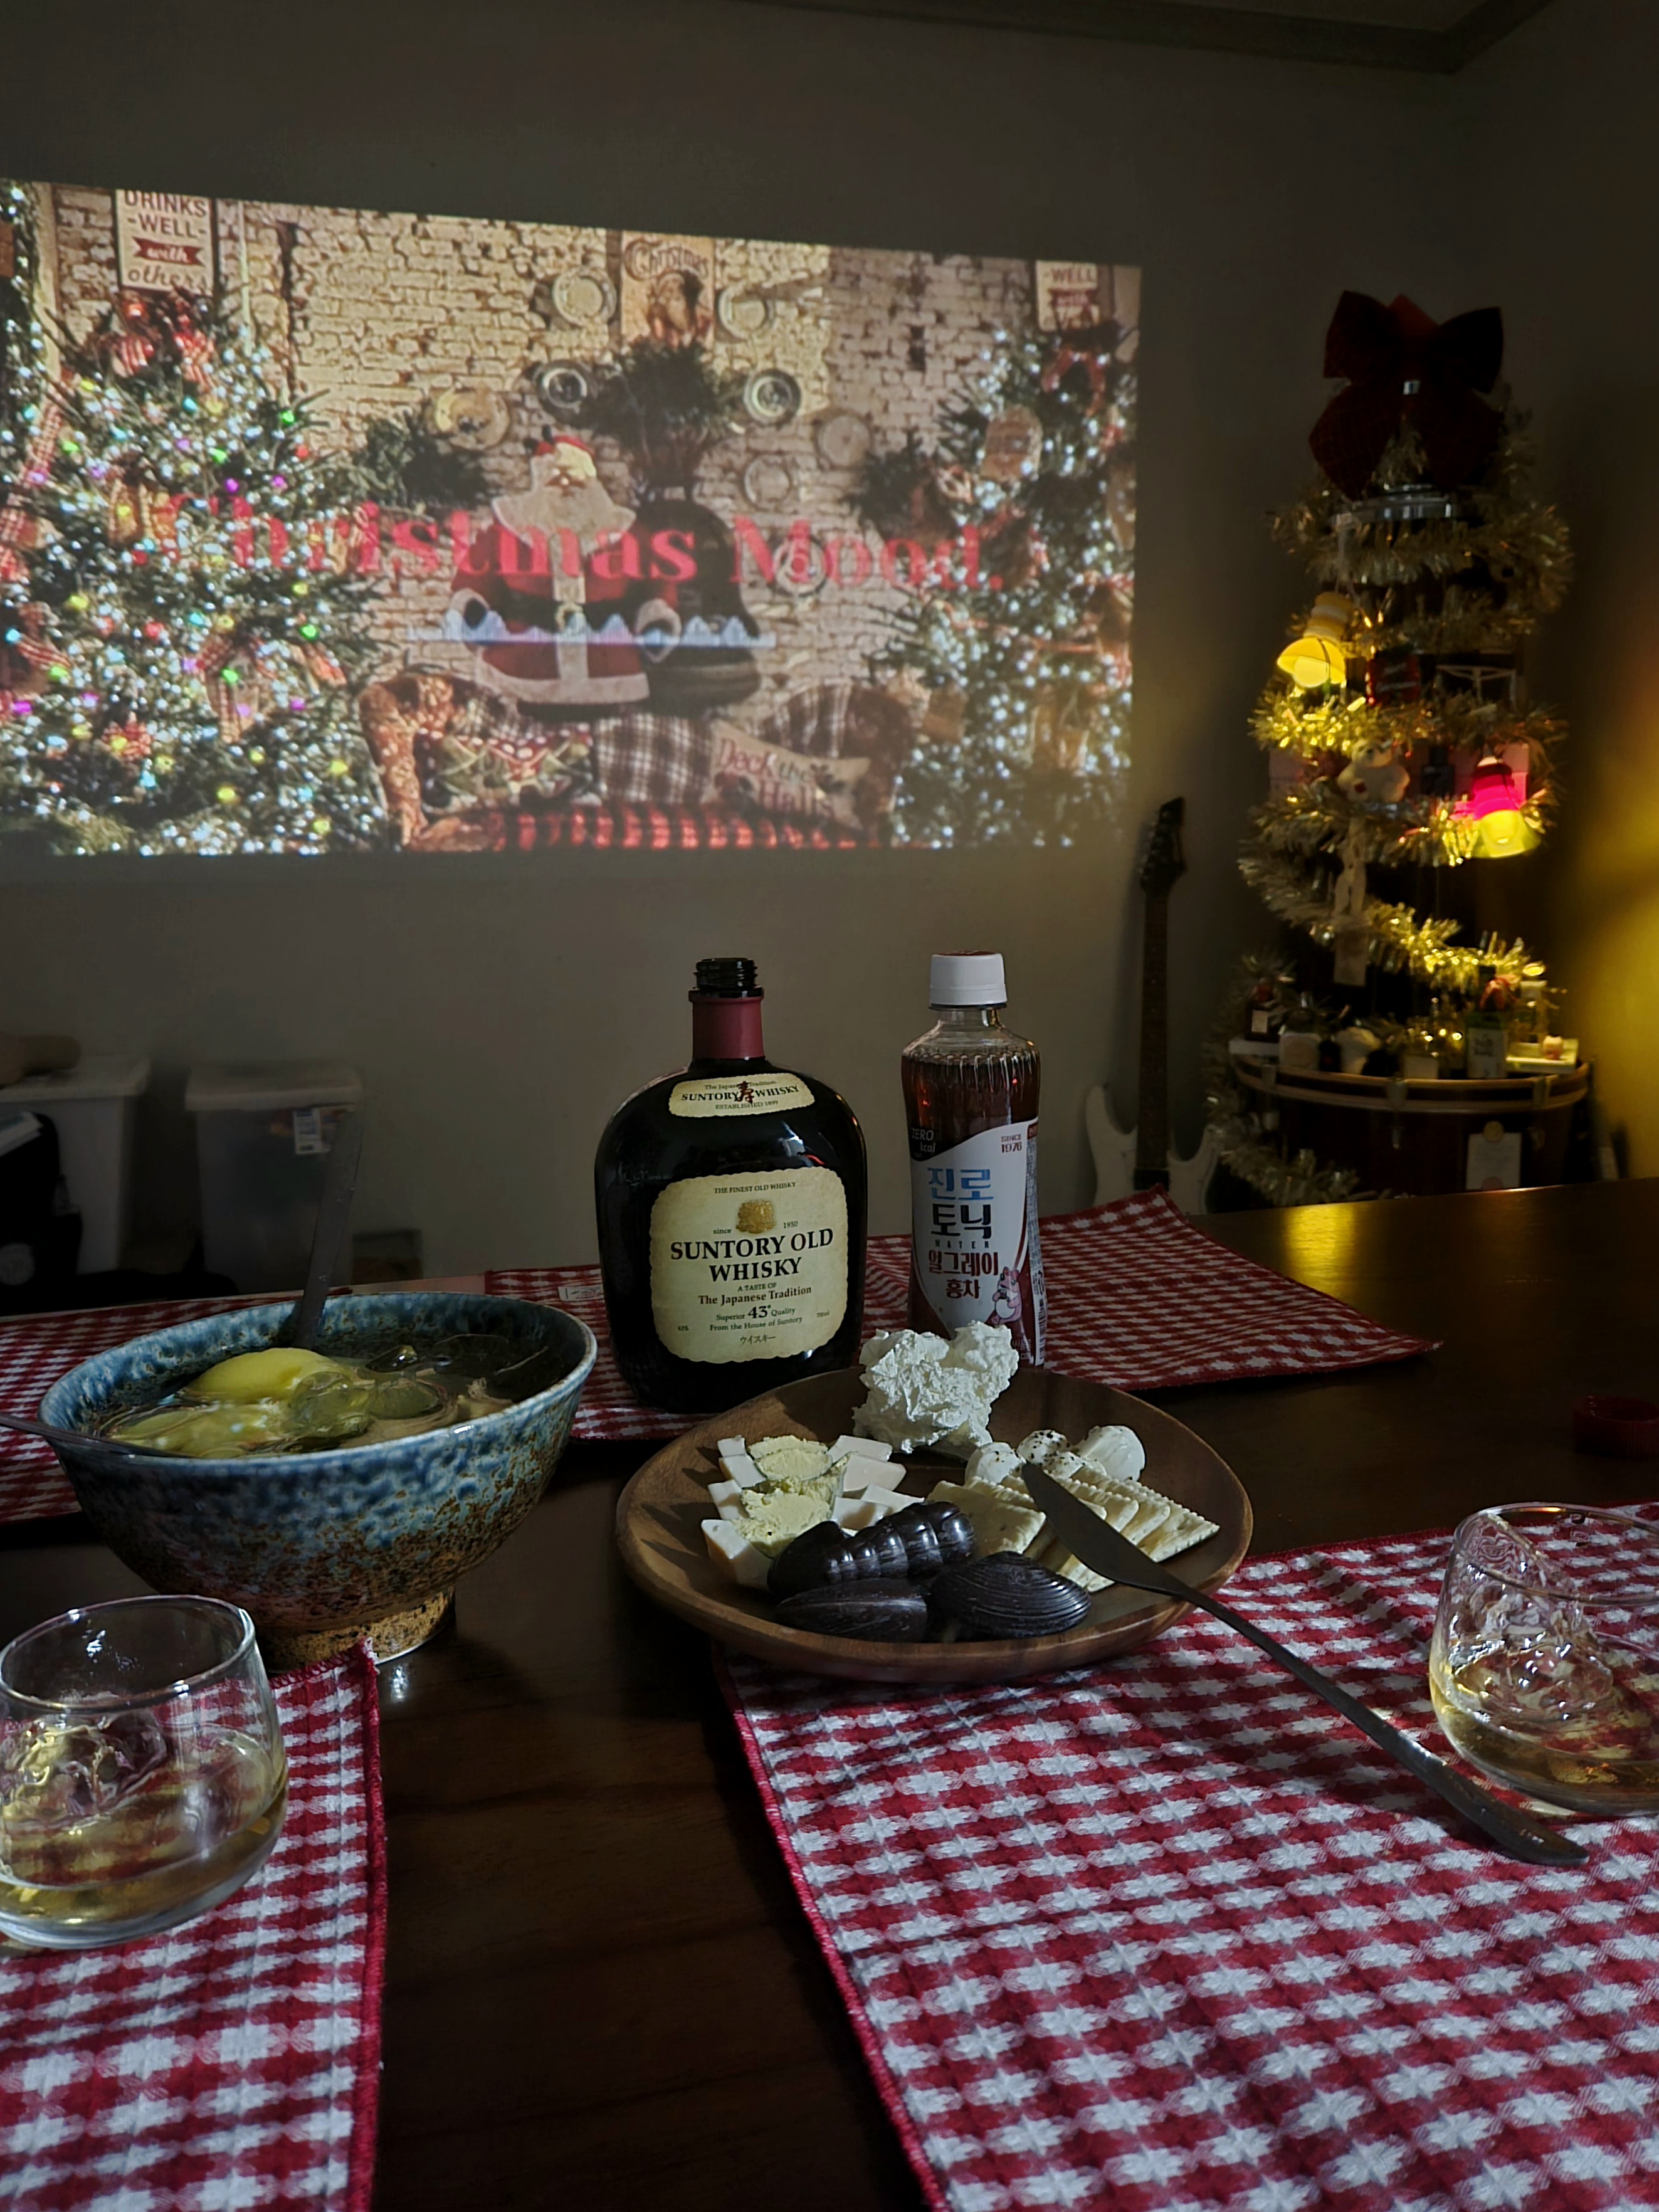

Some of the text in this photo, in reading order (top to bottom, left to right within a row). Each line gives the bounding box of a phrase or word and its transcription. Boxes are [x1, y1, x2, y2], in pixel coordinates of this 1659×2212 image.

[124, 190, 207, 218] DRINKS
[147, 245, 191, 263] with
[681, 1092, 739, 1102] SUNTORY
[754, 1085, 799, 1097] WHISKY
[715, 1102, 763, 1110] ESTABLISHED
[911, 1128, 935, 1141] ZERO
[1001, 1134, 1021, 1142] SINCE
[927, 1167, 994, 1200] 진로
[930, 1204, 992, 1240] 토닉
[670, 1228, 833, 1260] SUNTORY OLD
[935, 1240, 989, 1249] WATER
[709, 1256, 802, 1282] WHISKY
[929, 1250, 998, 1277] 얼그레이
[698, 1287, 812, 1306] The Japanese Tradition
[945, 1279, 981, 1299] 홍차
[716, 1314, 745, 1322] Superior
[771, 1307, 796, 1317] Quality
[744, 1321, 767, 1329] House
[777, 1317, 803, 1326] Suntory
[740, 1334, 776, 1346] ウイスキー
